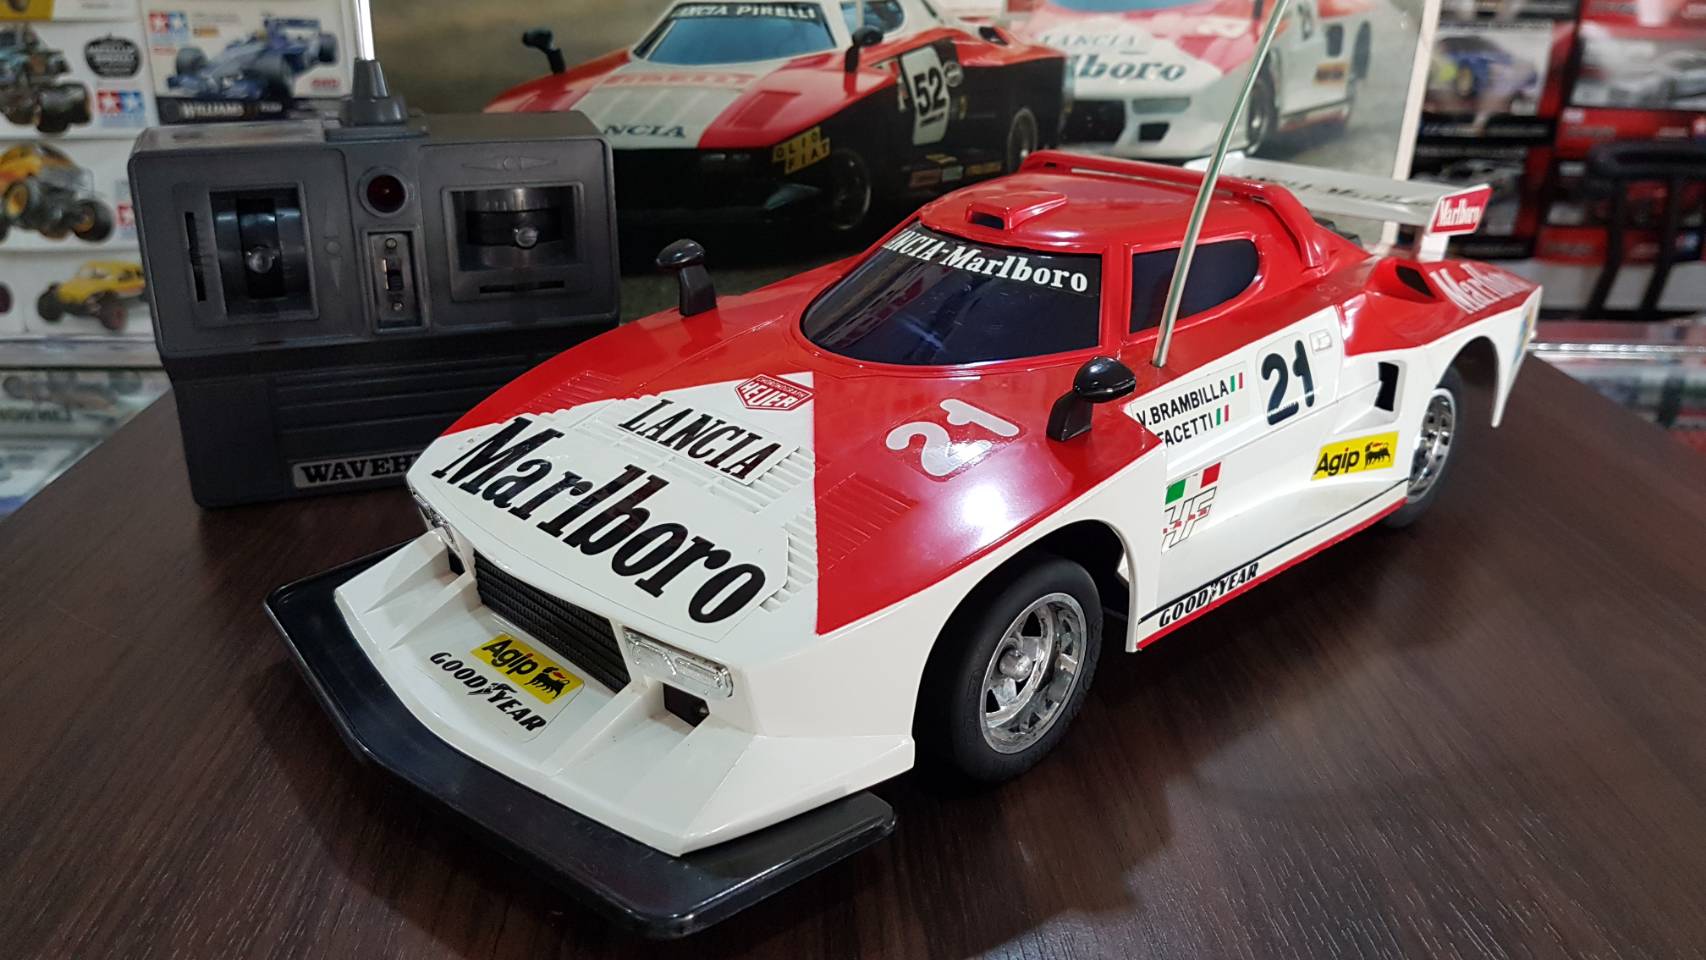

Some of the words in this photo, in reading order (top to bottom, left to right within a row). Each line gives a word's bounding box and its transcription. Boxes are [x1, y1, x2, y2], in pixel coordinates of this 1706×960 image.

[736, 5, 816, 18] PIRELLI
[913, 67, 947, 116] 52
[740, 380, 798, 408] HEUER
[1136, 379, 1229, 428] V.BRAMBILLA
[1260, 339, 1315, 426] 21
[618, 398, 783, 480] LANCIA
[885, 398, 1020, 477] 21
[1314, 447, 1360, 477] Agip
[431, 416, 766, 624] Marlboro
[481, 638, 539, 676] Agip
